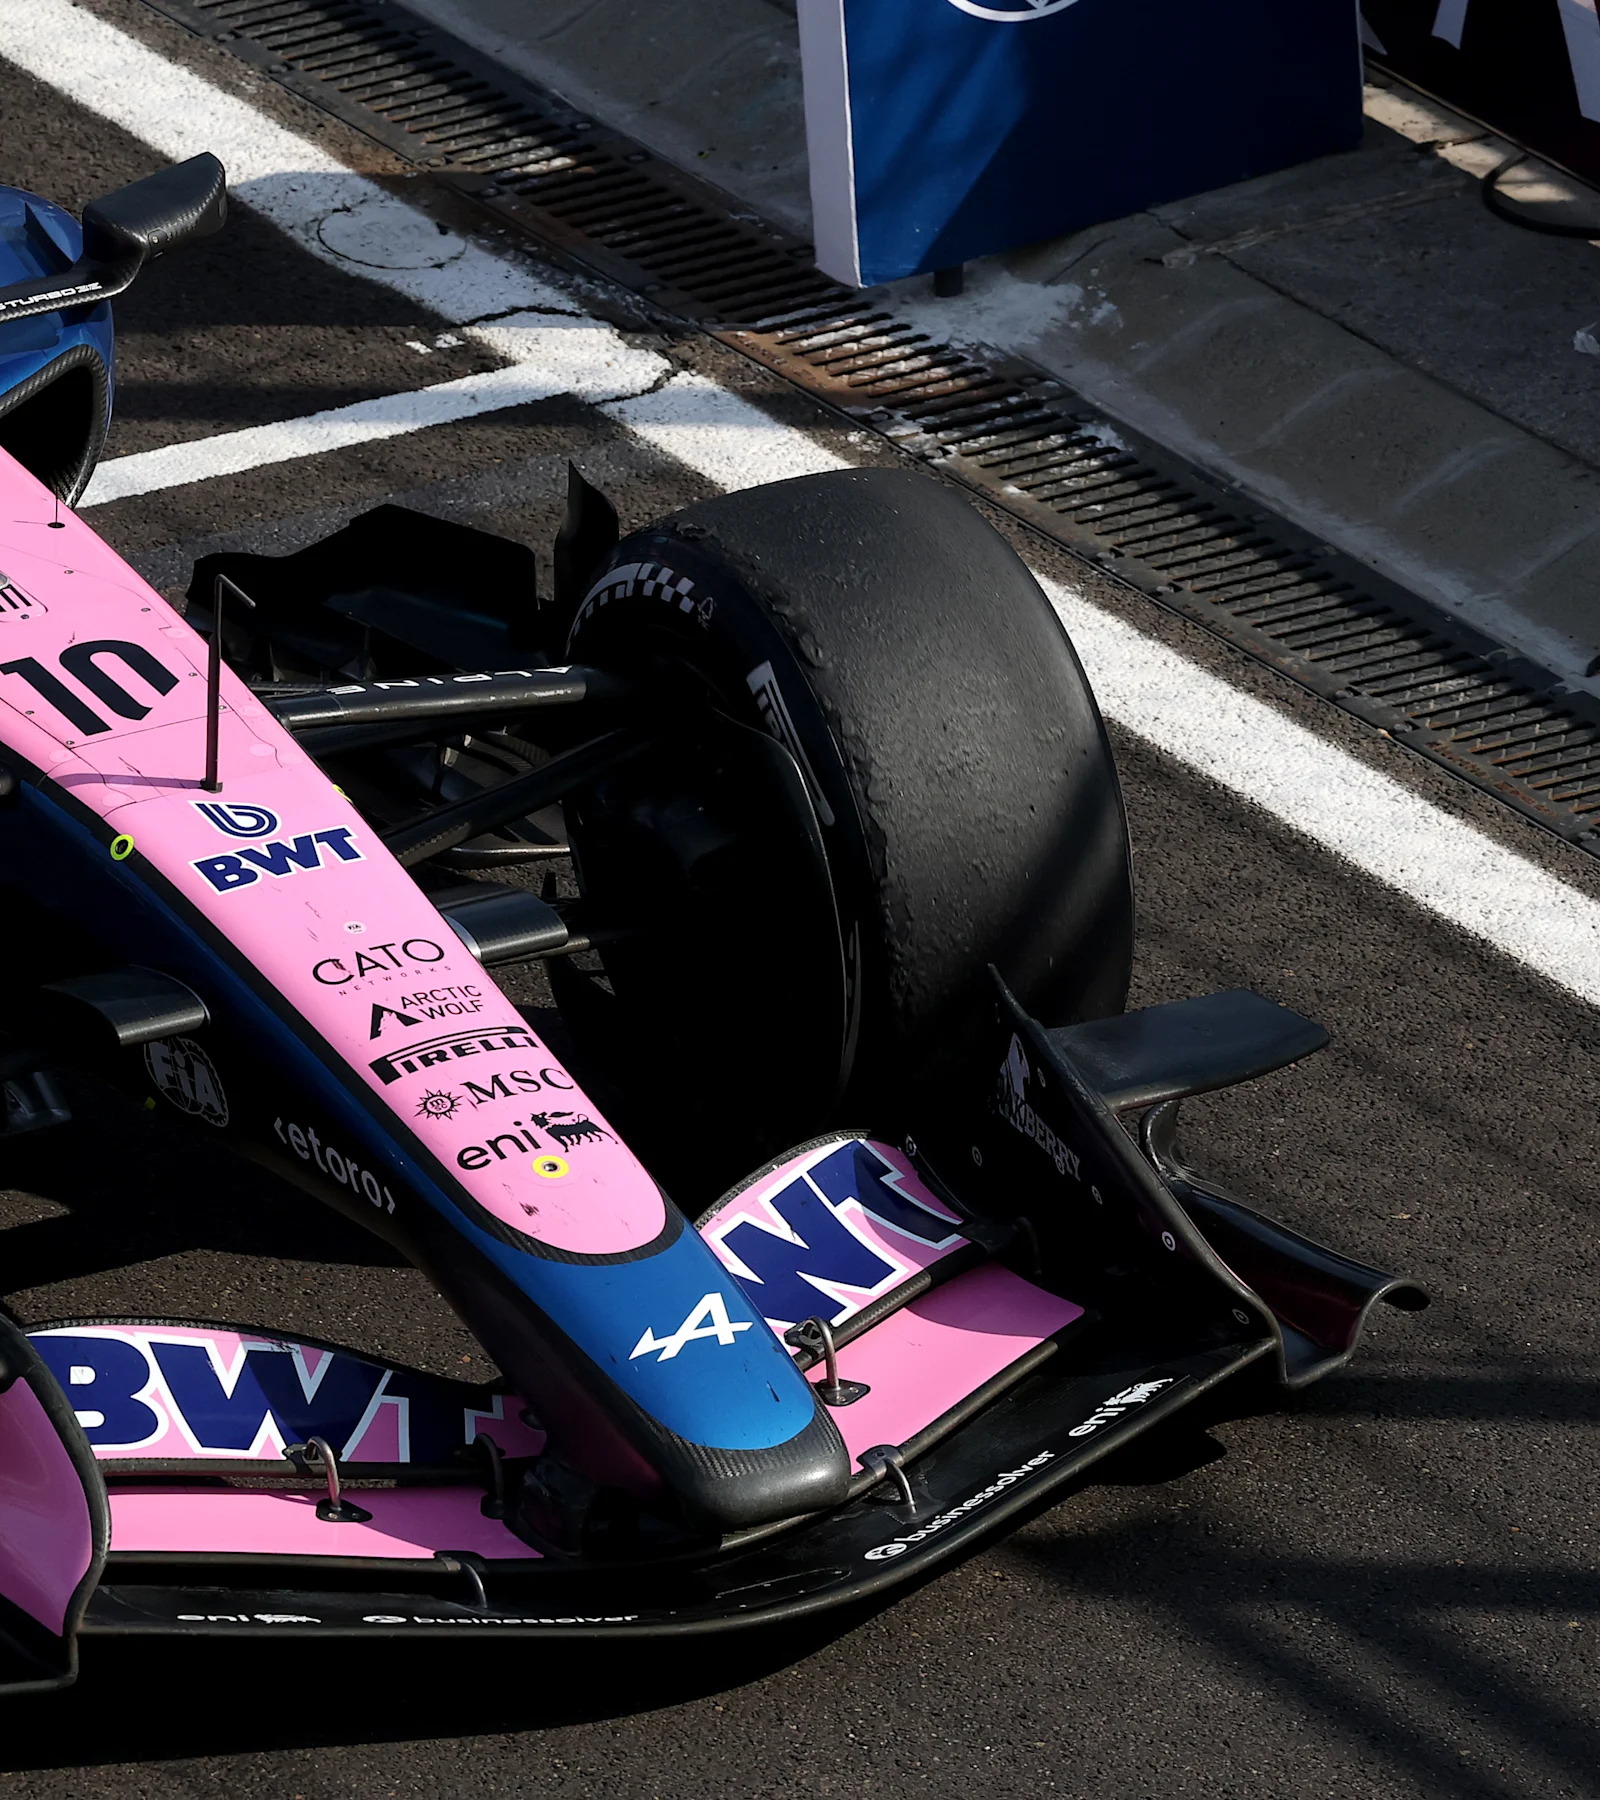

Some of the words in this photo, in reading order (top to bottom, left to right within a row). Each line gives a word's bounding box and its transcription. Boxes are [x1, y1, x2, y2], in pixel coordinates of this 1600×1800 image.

[326, 664, 573, 695] ALPINE
[192, 827, 363, 893] BWT
[312, 938, 445, 986] CATO
[338, 965, 452, 997] NETWORKS
[400, 985, 482, 1010] ARCTIC
[418, 999, 484, 1020] WOLF
[368, 1026, 540, 1086] PIRELLI
[149, 1041, 224, 1116] FIA
[459, 1068, 574, 1106] MSC
[457, 1121, 542, 1171] eni
[708, 1138, 964, 1352] WT
[24, 1331, 504, 1464] BWT
[1068, 1403, 1127, 1437] eni
[893, 1450, 1055, 1544] businessolver
[176, 1613, 250, 1622] eni
[413, 1615, 639, 1624] businessolver
